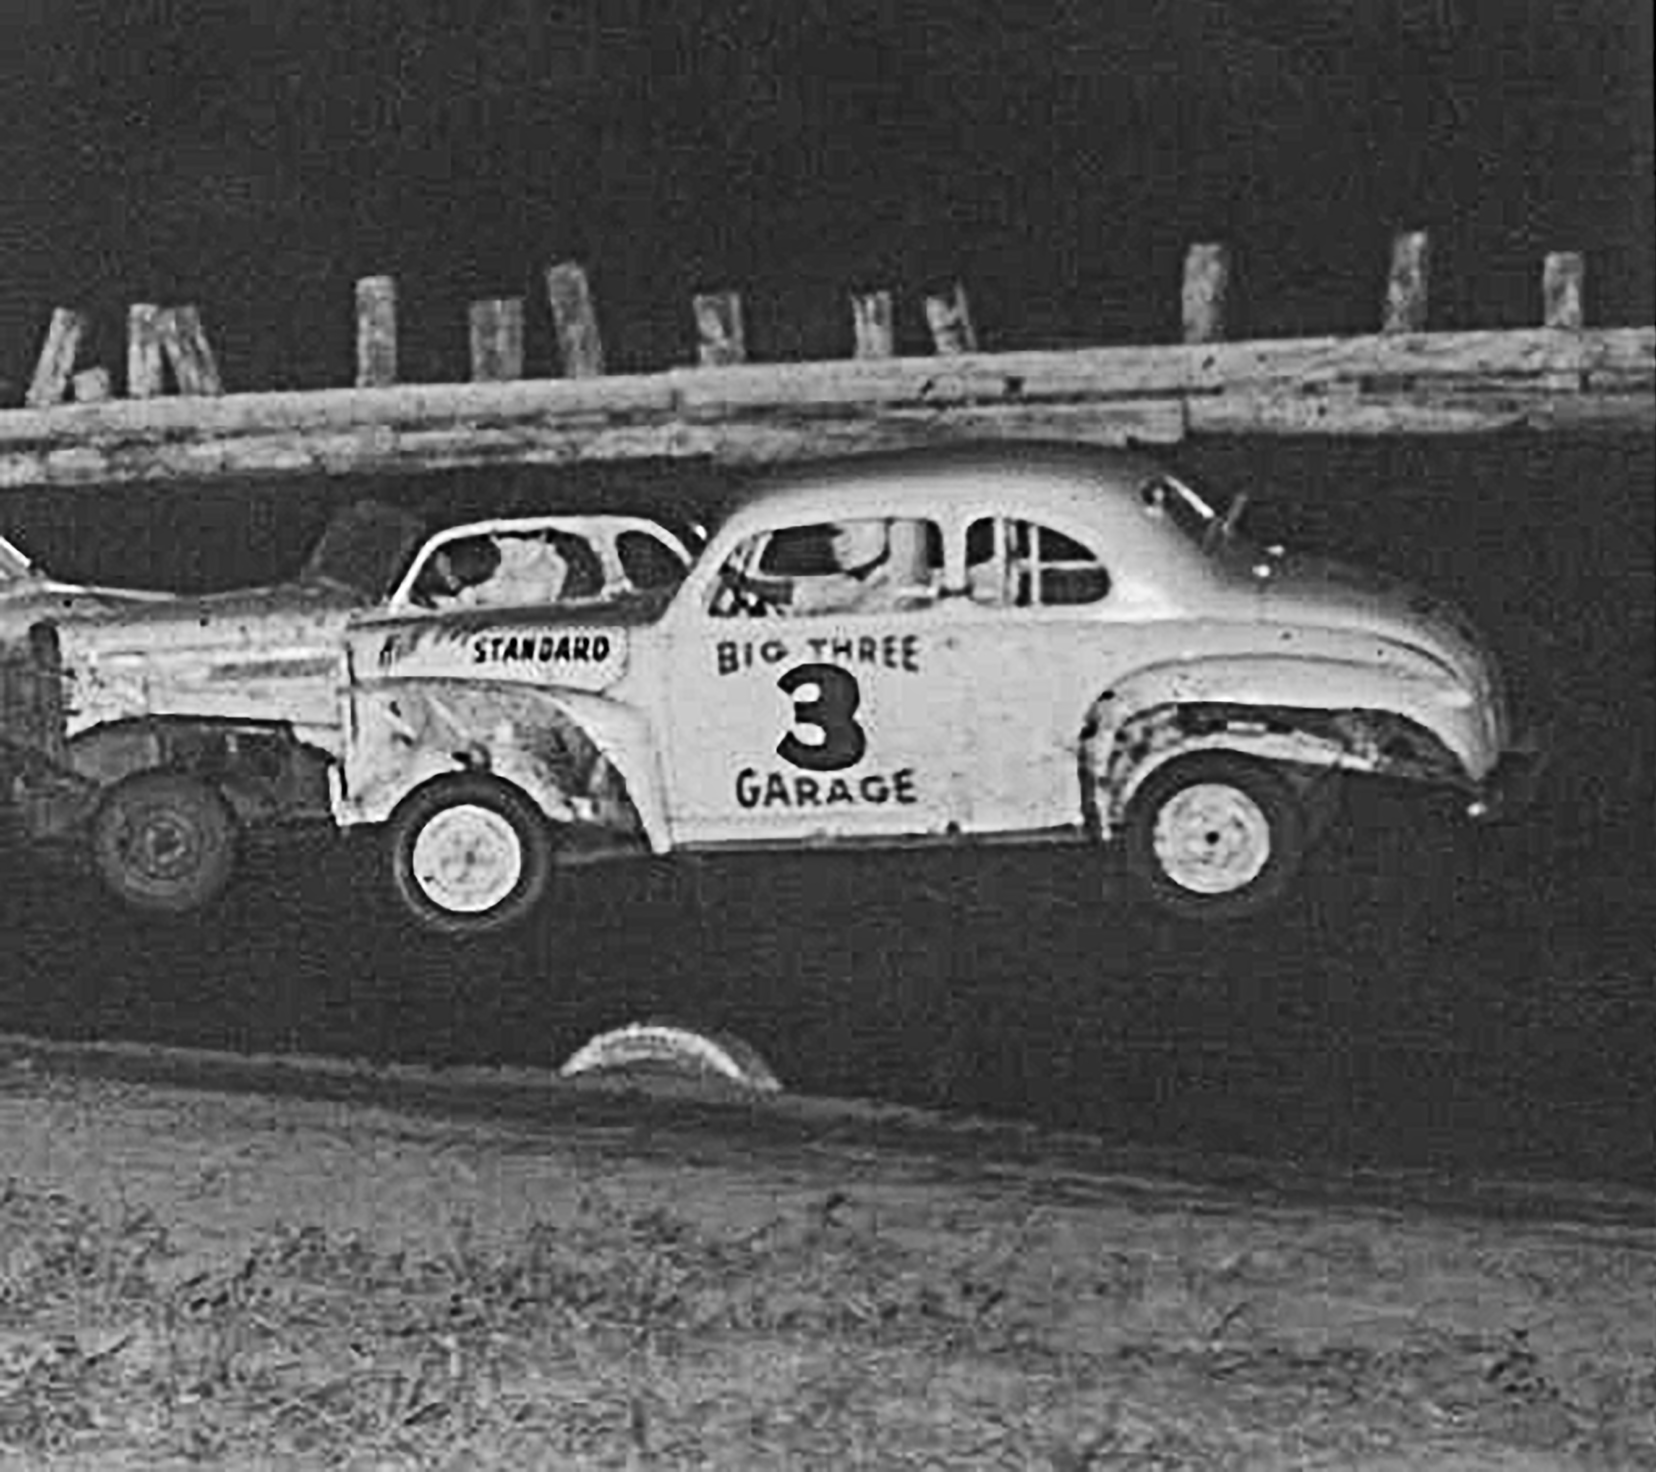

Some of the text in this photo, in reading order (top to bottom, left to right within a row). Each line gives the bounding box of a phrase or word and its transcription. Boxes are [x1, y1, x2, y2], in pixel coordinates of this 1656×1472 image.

[473, 636, 610, 664] STANDARD
[716, 634, 920, 676] BIG THREE
[776, 662, 867, 772] 3
[735, 766, 918, 808] GARAGE
